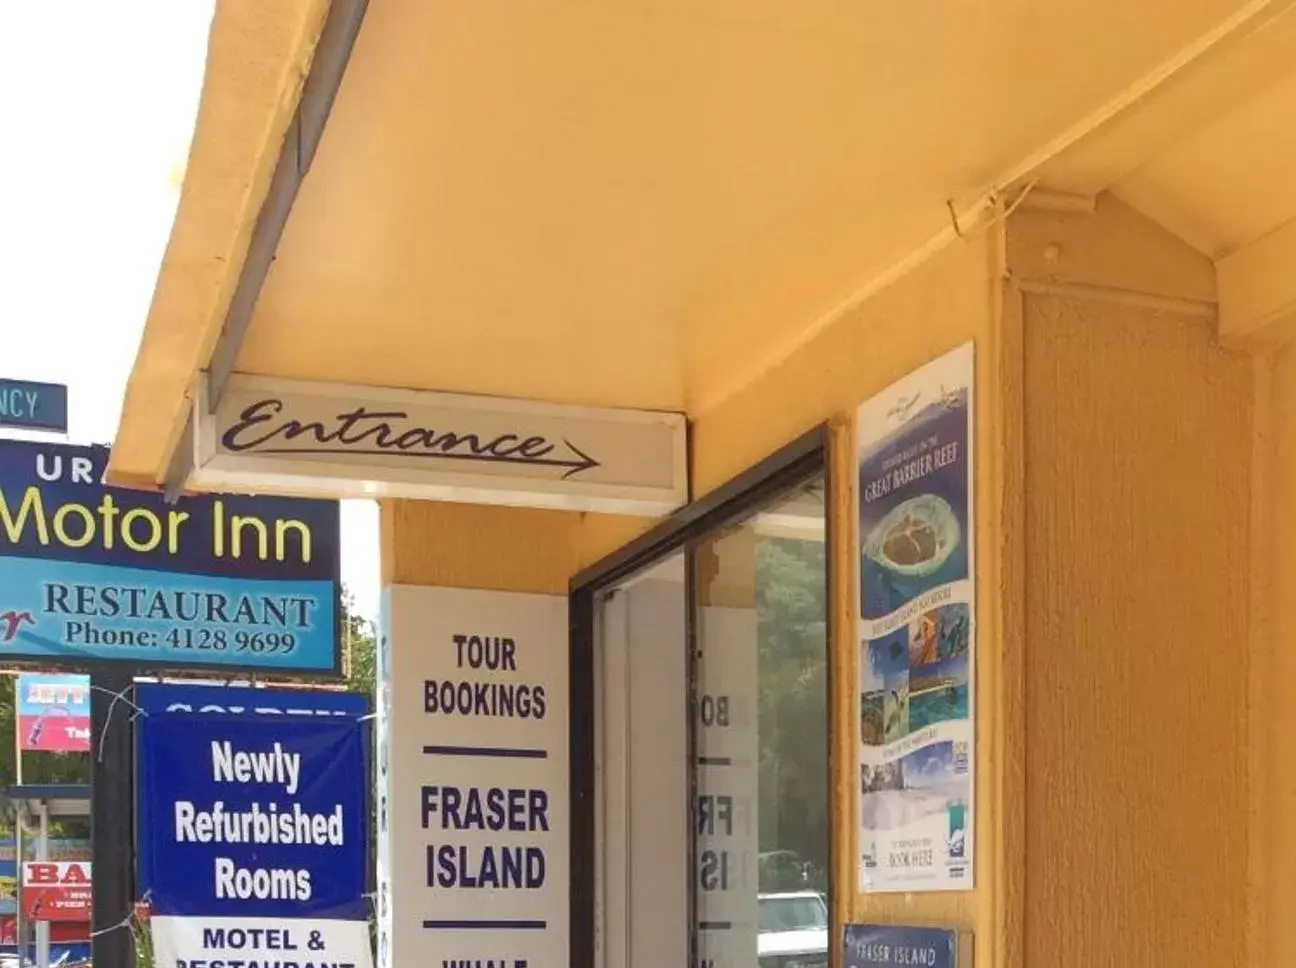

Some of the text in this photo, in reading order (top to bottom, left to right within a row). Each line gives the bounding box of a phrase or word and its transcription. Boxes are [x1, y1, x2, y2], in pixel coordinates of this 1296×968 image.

[222, 399, 554, 457] Entrance
[865, 473, 892, 503] GREAT
[893, 453, 933, 489] BARRIER
[934, 442, 959, 472] REEF
[0, 486, 312, 563] Motor Inn
[45, 583, 314, 627] RESTAURANT
[66, 622, 295, 654] Phone: 4128 9699
[453, 635, 516, 671] TOUR
[424, 681, 546, 720] BOOKINGS
[211, 741, 300, 794] Newly
[175, 801, 344, 846] Refurbished
[421, 786, 549, 832] FRASER
[215, 857, 312, 901] Rooms
[426, 845, 546, 889] ISLAND
[203, 928, 325, 951] MOTEL &
[856, 943, 936, 968] FRASER ISLAND
